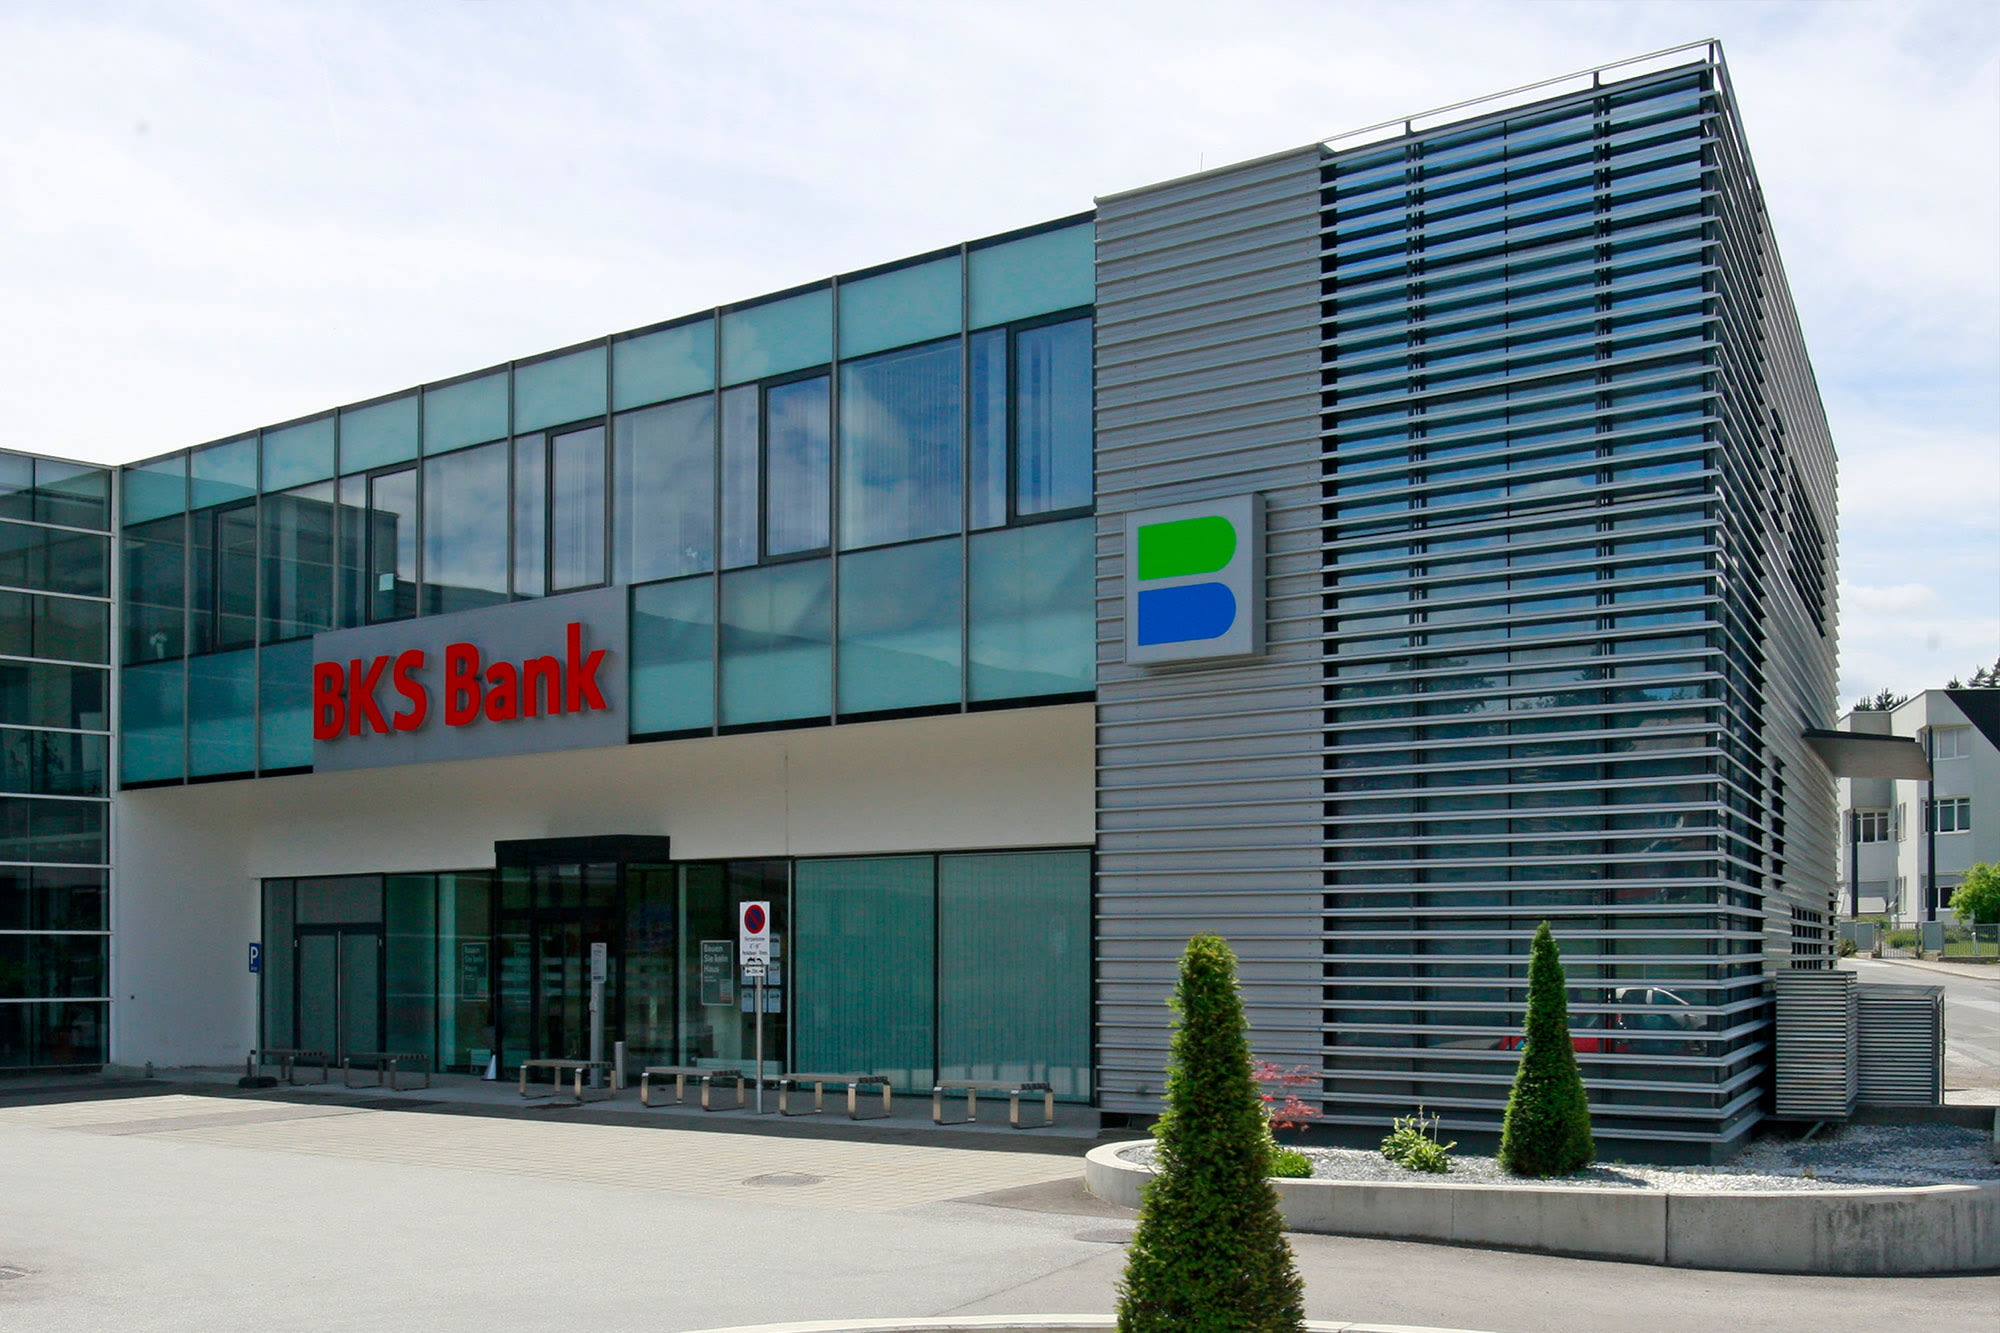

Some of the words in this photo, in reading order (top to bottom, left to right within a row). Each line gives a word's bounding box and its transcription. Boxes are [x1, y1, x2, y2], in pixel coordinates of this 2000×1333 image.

[313, 649, 427, 740] BKS
[445, 622, 607, 726] Bank
[251, 946, 259, 964] P
